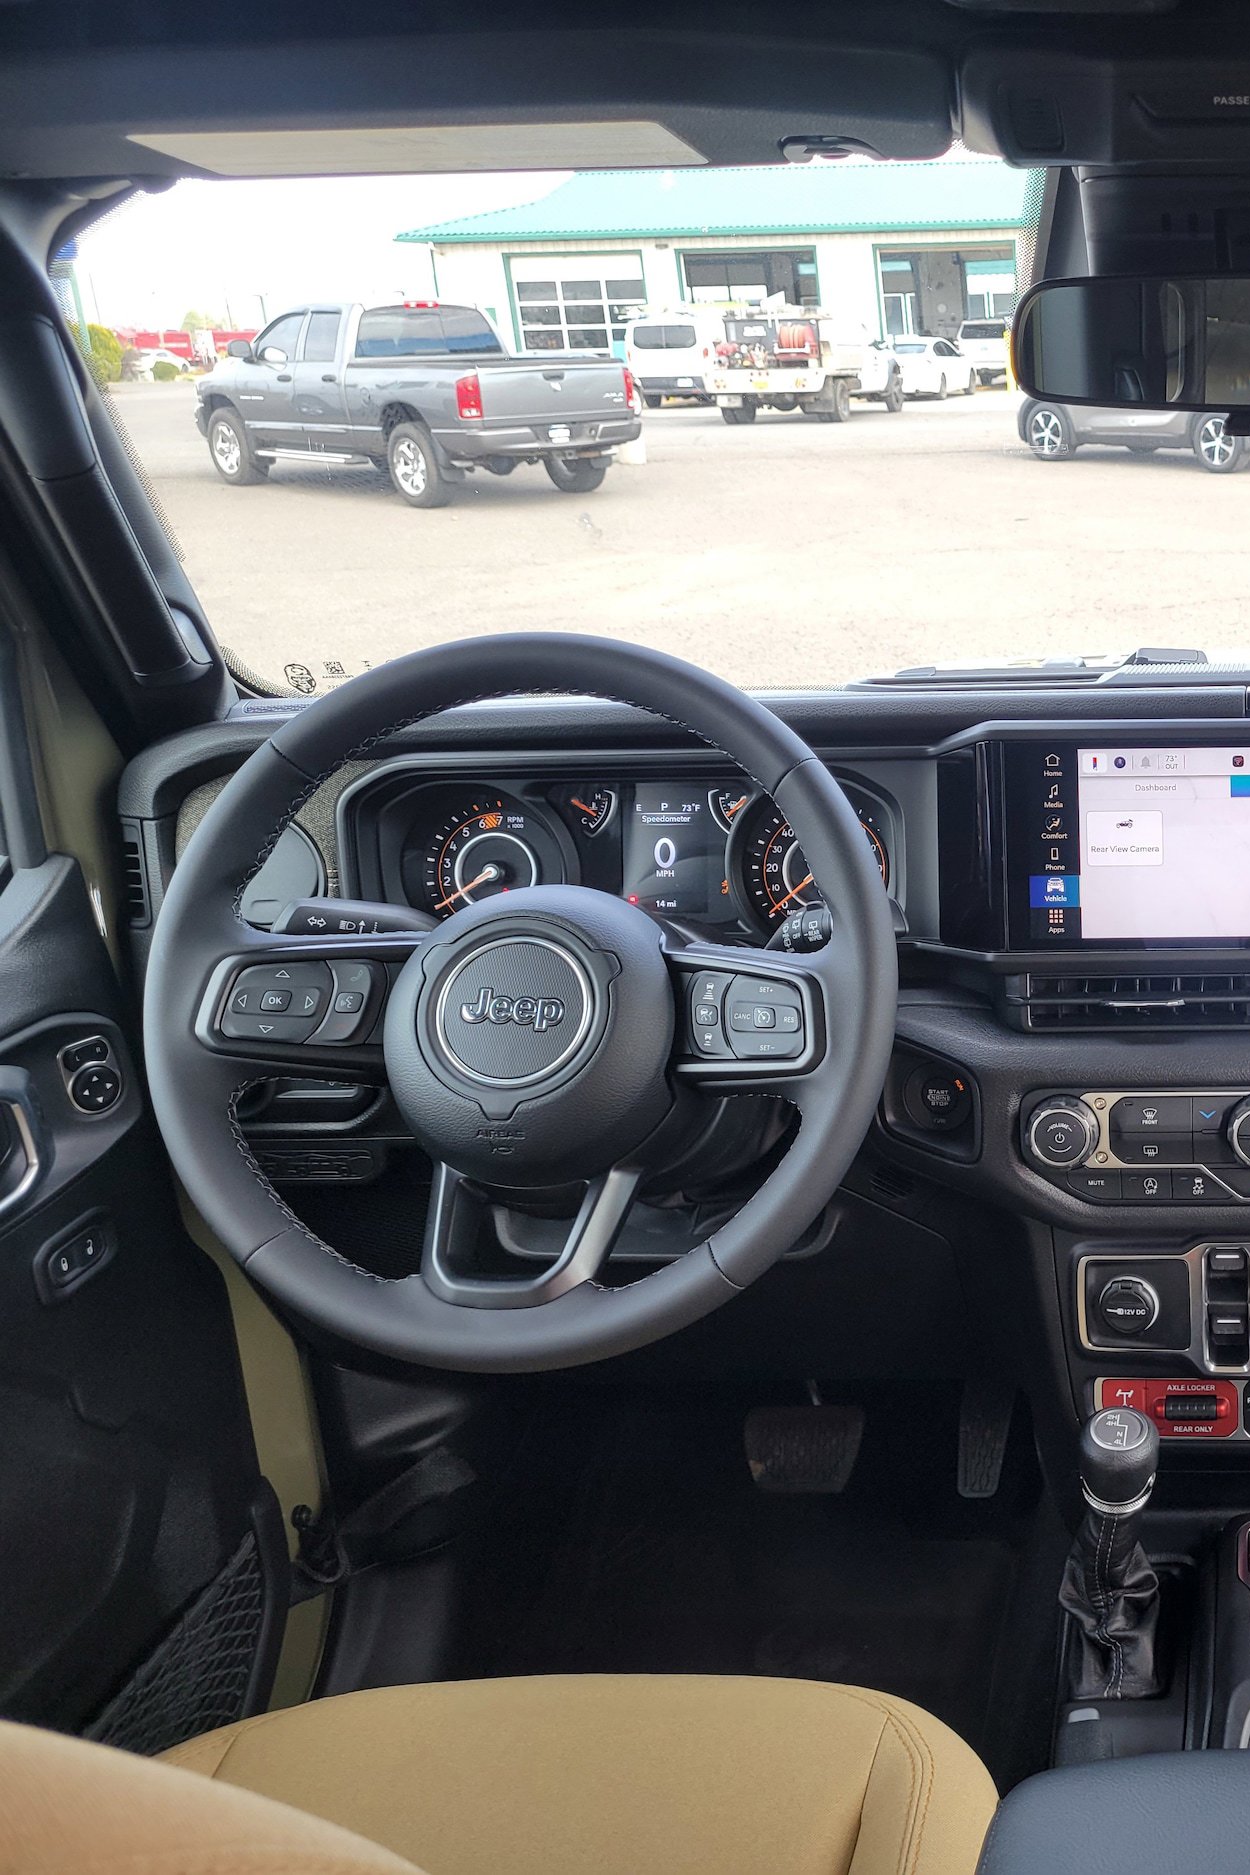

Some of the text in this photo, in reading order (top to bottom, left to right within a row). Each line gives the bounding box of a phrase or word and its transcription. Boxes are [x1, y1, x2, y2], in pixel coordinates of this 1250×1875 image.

[661, 803, 668, 811] P
[682, 803, 700, 811] 73°F
[479, 819, 486, 828] 6
[497, 816, 503, 826] 7
[642, 815, 690, 824] Speedometer
[462, 827, 470, 837] 5
[782, 829, 794, 837] 40
[450, 841, 457, 851] 4
[654, 837, 676, 868] 0
[444, 858, 451, 868] 3
[766, 864, 778, 872] 20
[444, 877, 451, 886] 2
[461, 987, 565, 1032] Jeep
[96, 1046, 101, 1054] R
